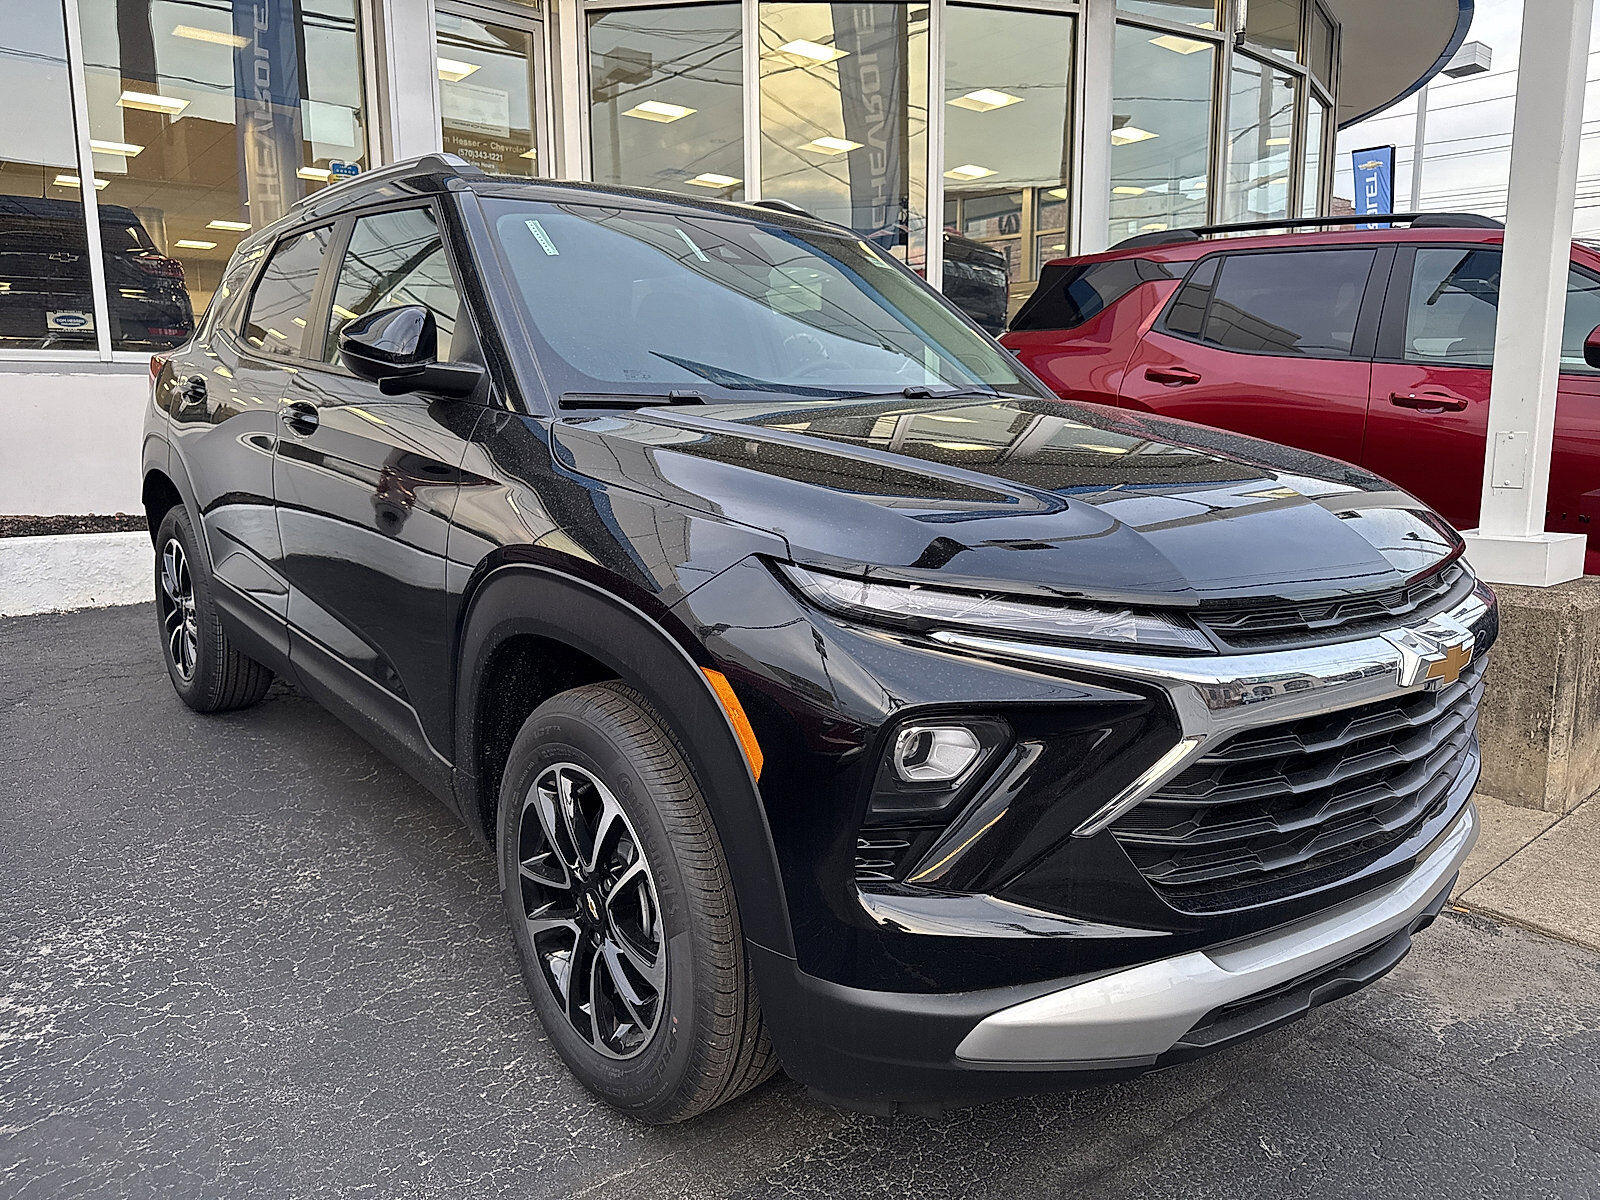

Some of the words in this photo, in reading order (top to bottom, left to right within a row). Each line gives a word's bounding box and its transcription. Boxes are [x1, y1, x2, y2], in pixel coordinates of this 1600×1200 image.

[452, 135, 480, 148] Hesser
[490, 142, 526, 153] Chevrolet
[458, 148, 504, 162] (570)343-1221
